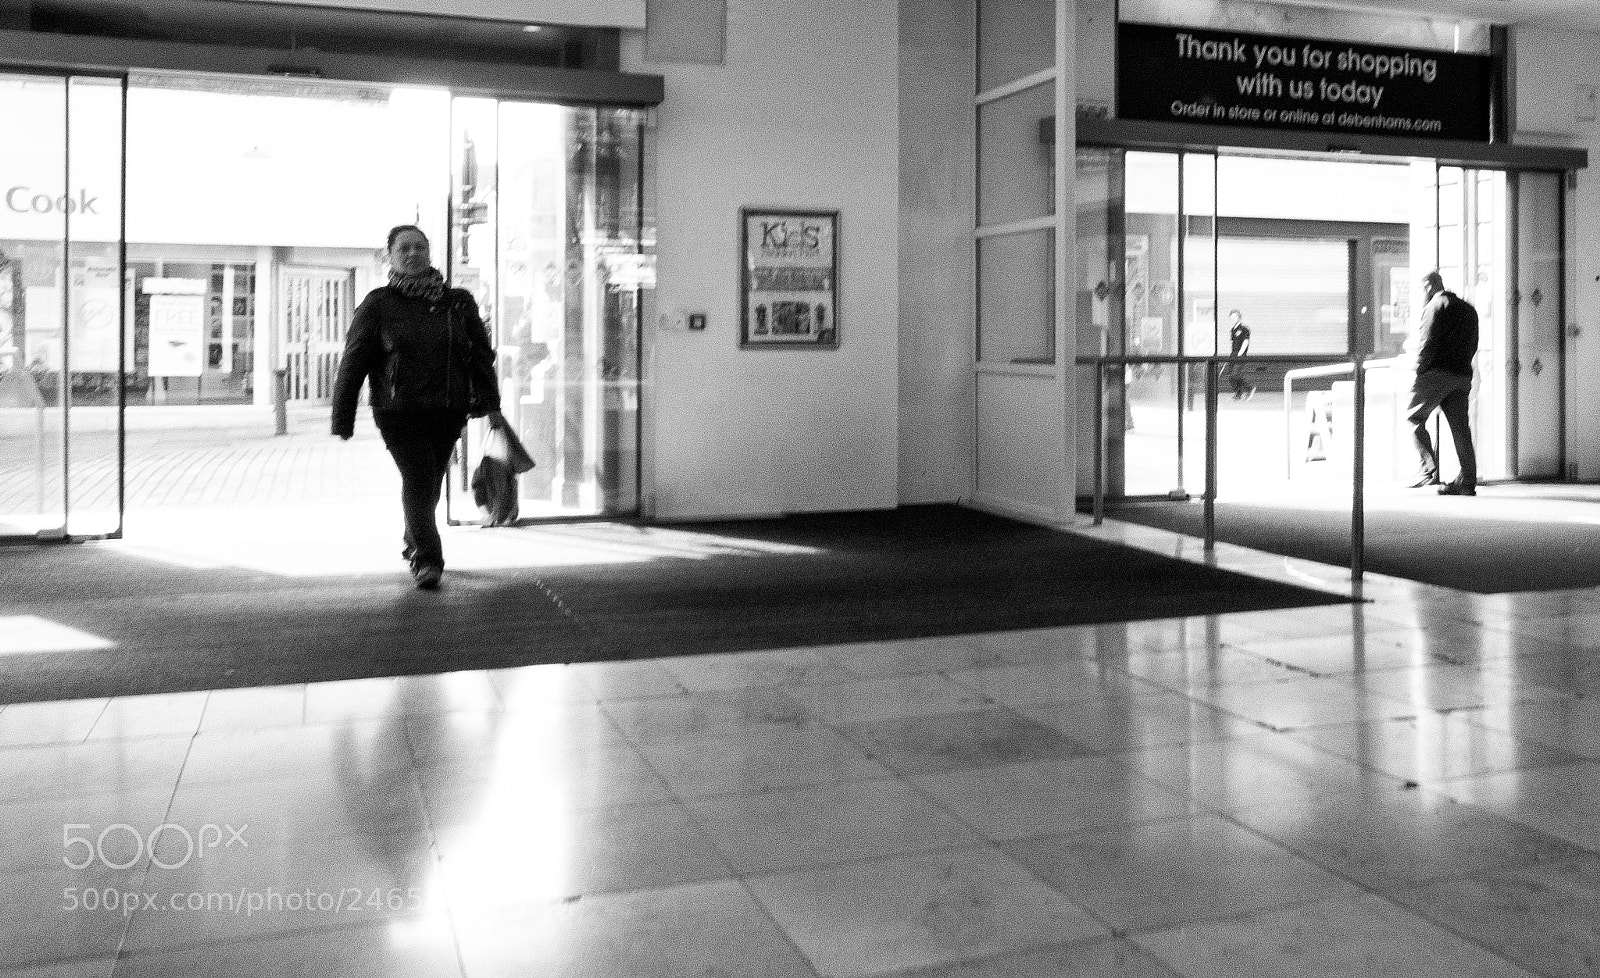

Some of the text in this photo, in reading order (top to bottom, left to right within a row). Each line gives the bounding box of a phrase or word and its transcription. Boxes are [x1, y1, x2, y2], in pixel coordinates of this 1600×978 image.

[1175, 32, 1438, 82] Thank you for shopping
[1236, 73, 1383, 108] with us today
[1171, 100, 1442, 133] Order in store or online at debenhams.com
[5, 186, 99, 215] Cook
